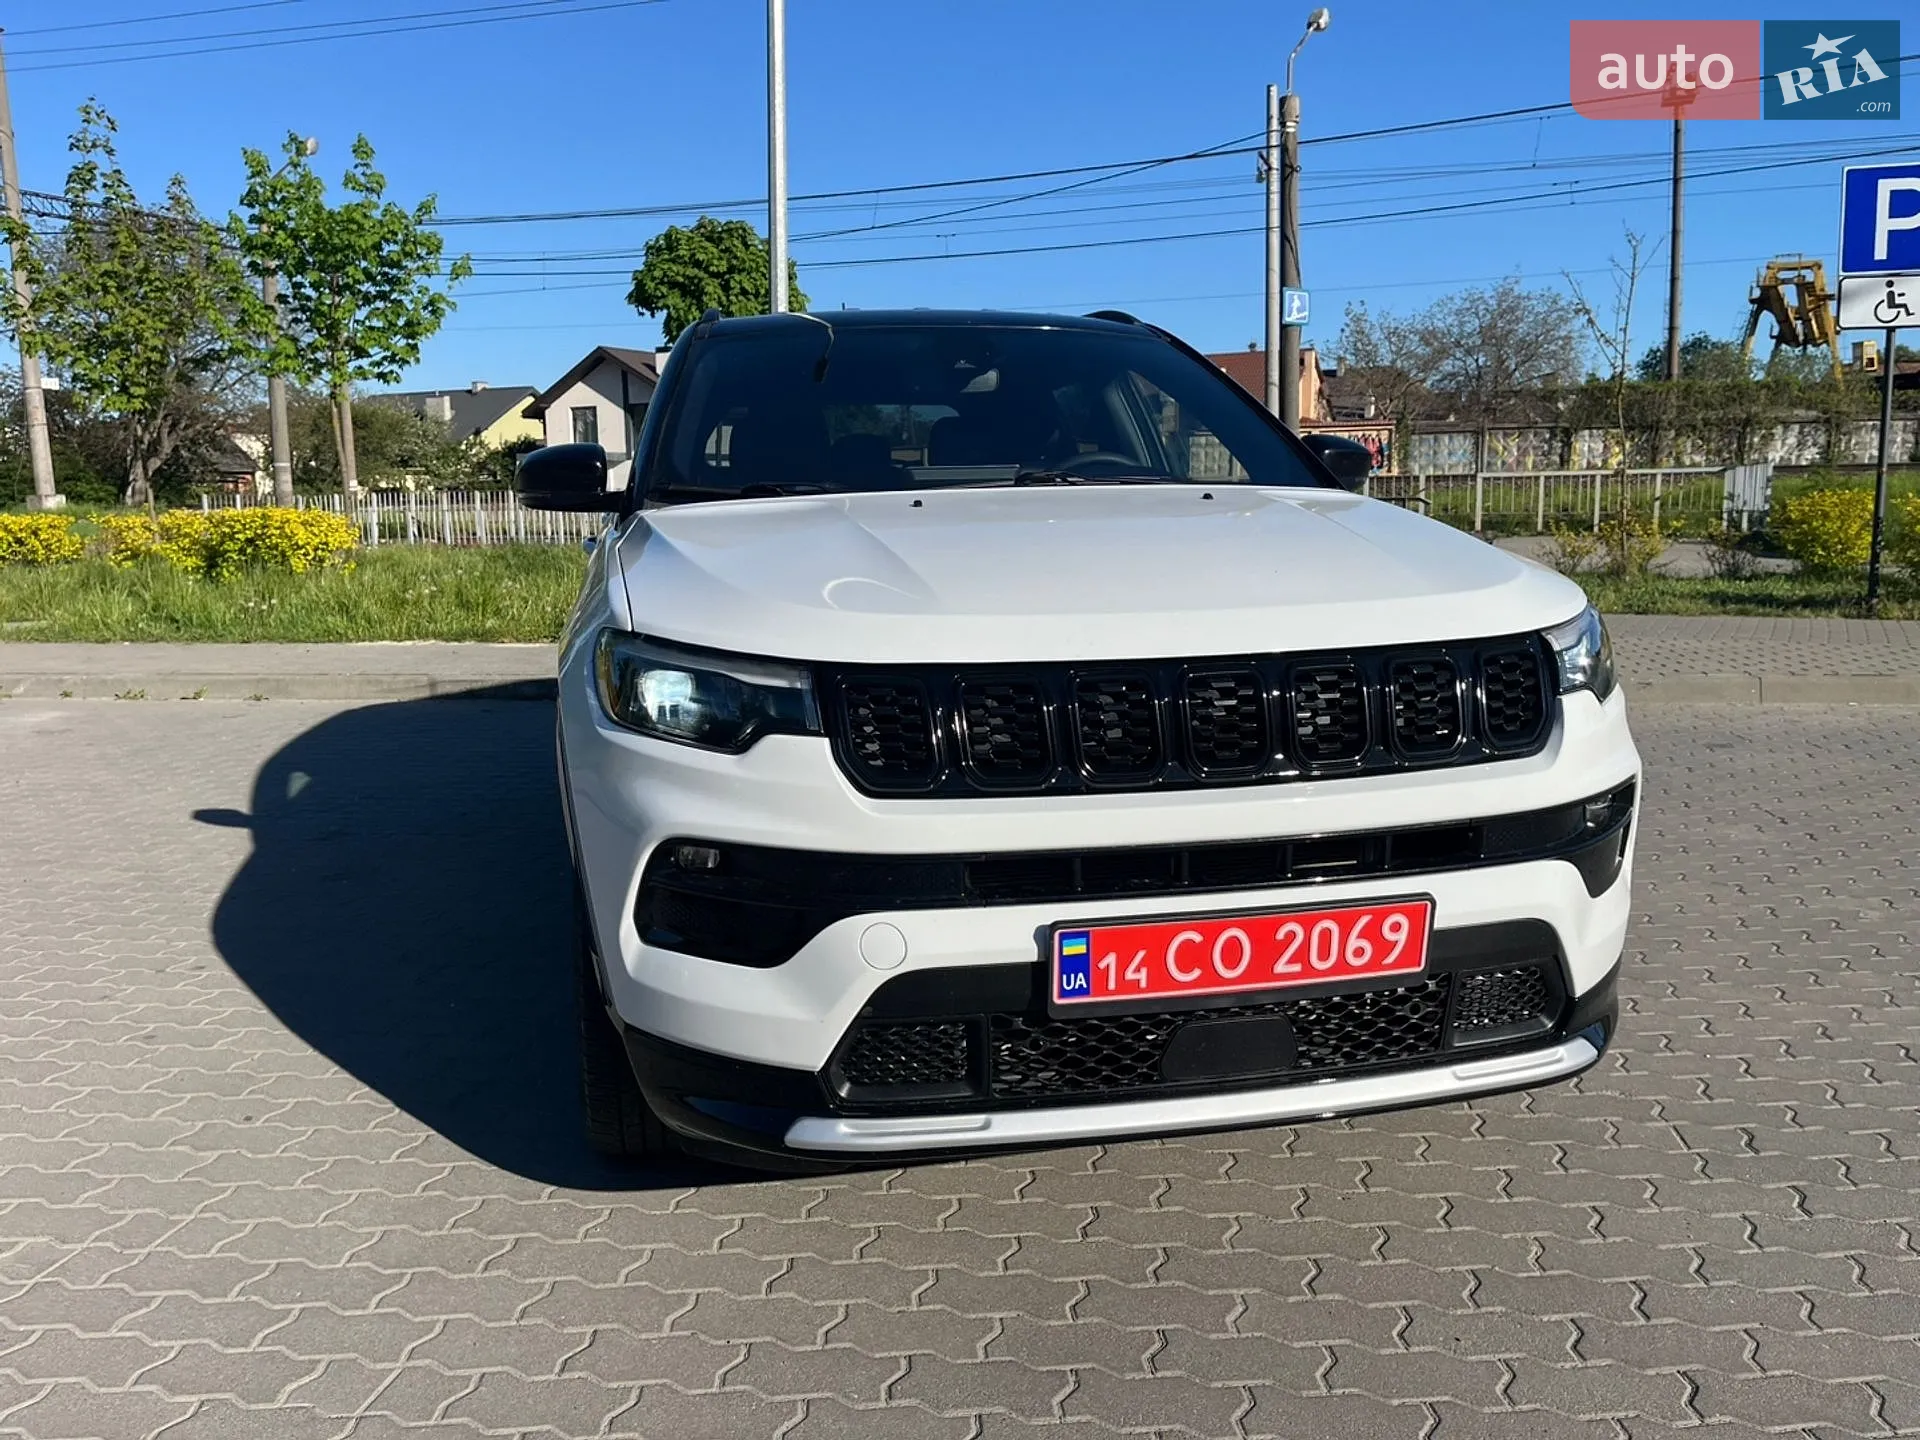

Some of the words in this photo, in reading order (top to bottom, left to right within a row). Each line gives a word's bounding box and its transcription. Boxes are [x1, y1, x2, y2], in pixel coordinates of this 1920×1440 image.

[1873, 177, 1920, 261] P
[1062, 972, 1087, 990] UA
[1097, 949, 1148, 991] 14
[1165, 929, 1251, 982] CO
[1274, 912, 1410, 973] 2069
